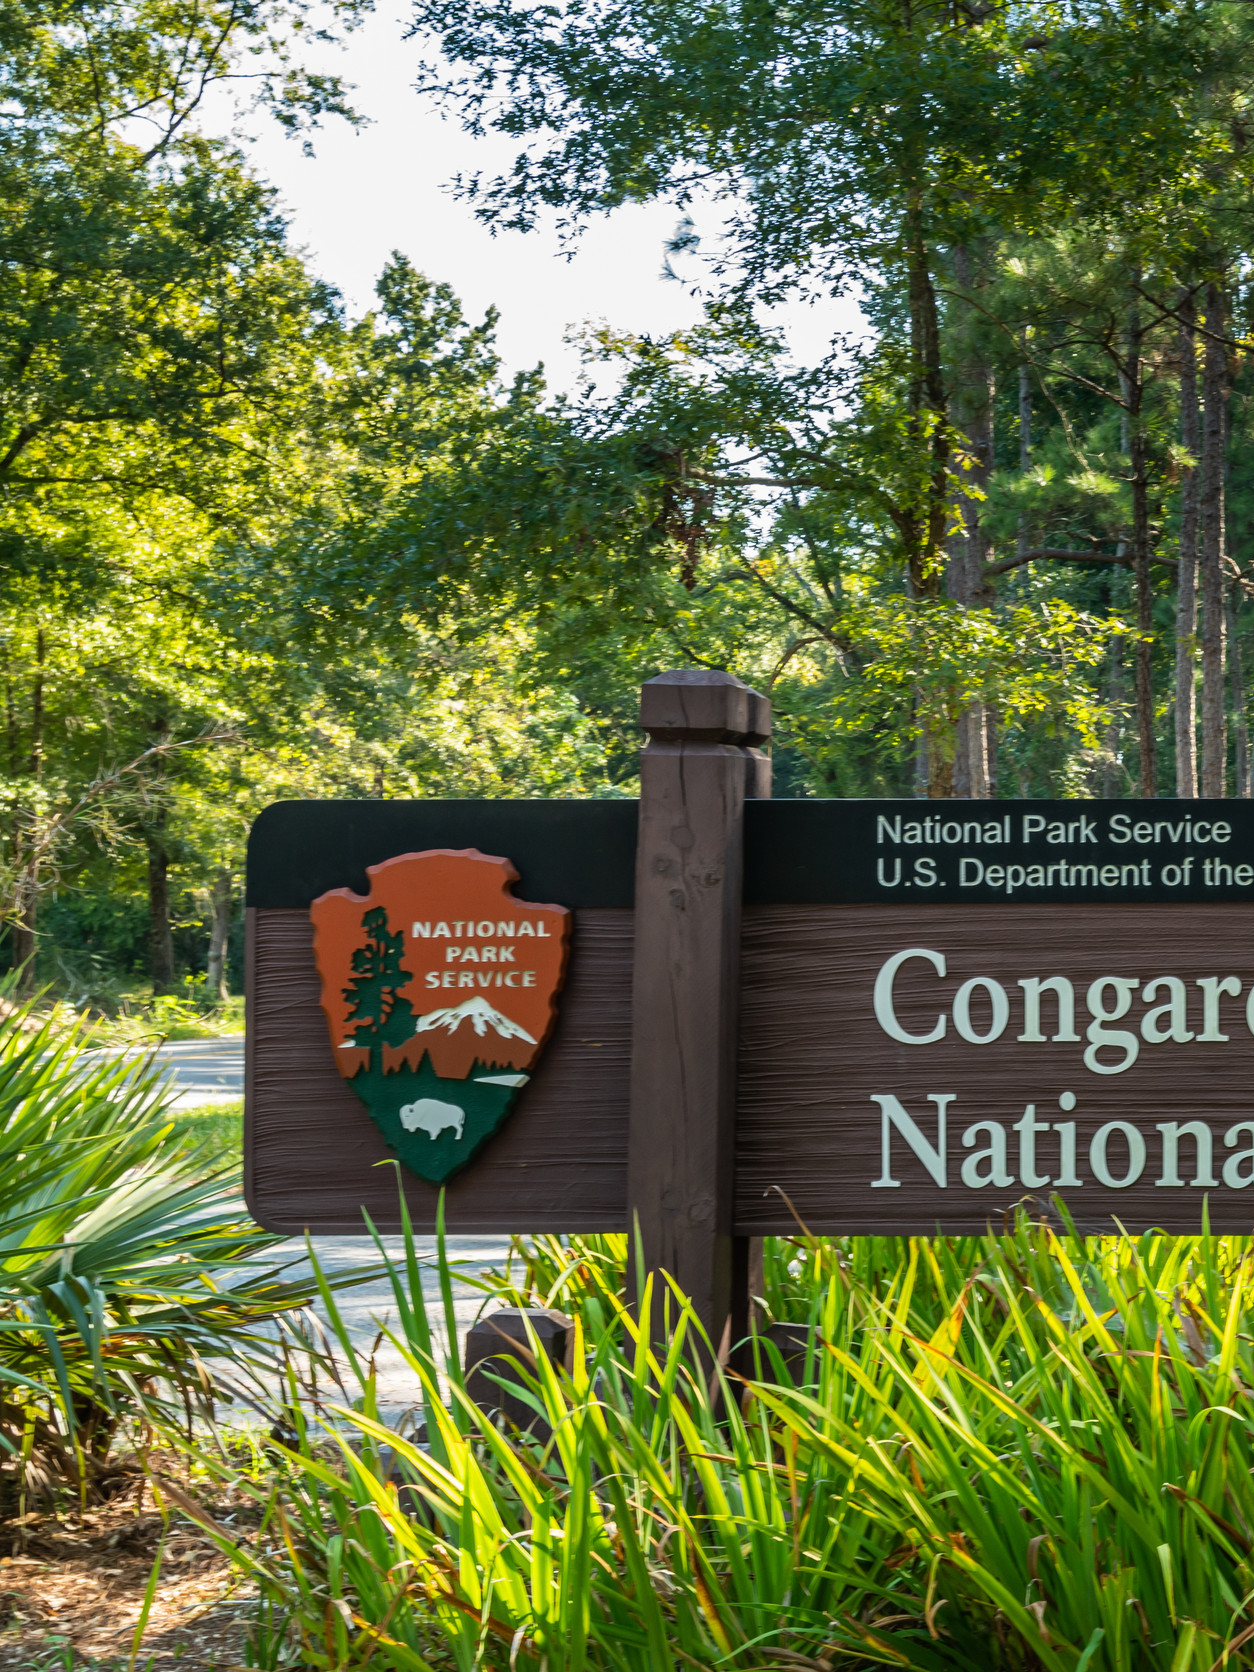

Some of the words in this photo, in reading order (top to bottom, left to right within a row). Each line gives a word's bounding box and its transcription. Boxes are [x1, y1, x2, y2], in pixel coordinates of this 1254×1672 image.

[877, 814, 1011, 844] National
[1022, 814, 1099, 844] Park
[1108, 813, 1232, 844] Service
[877, 857, 947, 887] U.S.
[959, 857, 1152, 894] Department
[1161, 856, 1195, 887] of
[1201, 857, 1254, 886] the
[411, 920, 551, 938] NATIONAL
[445, 945, 516, 963] PARK
[424, 971, 537, 989] SERVICE
